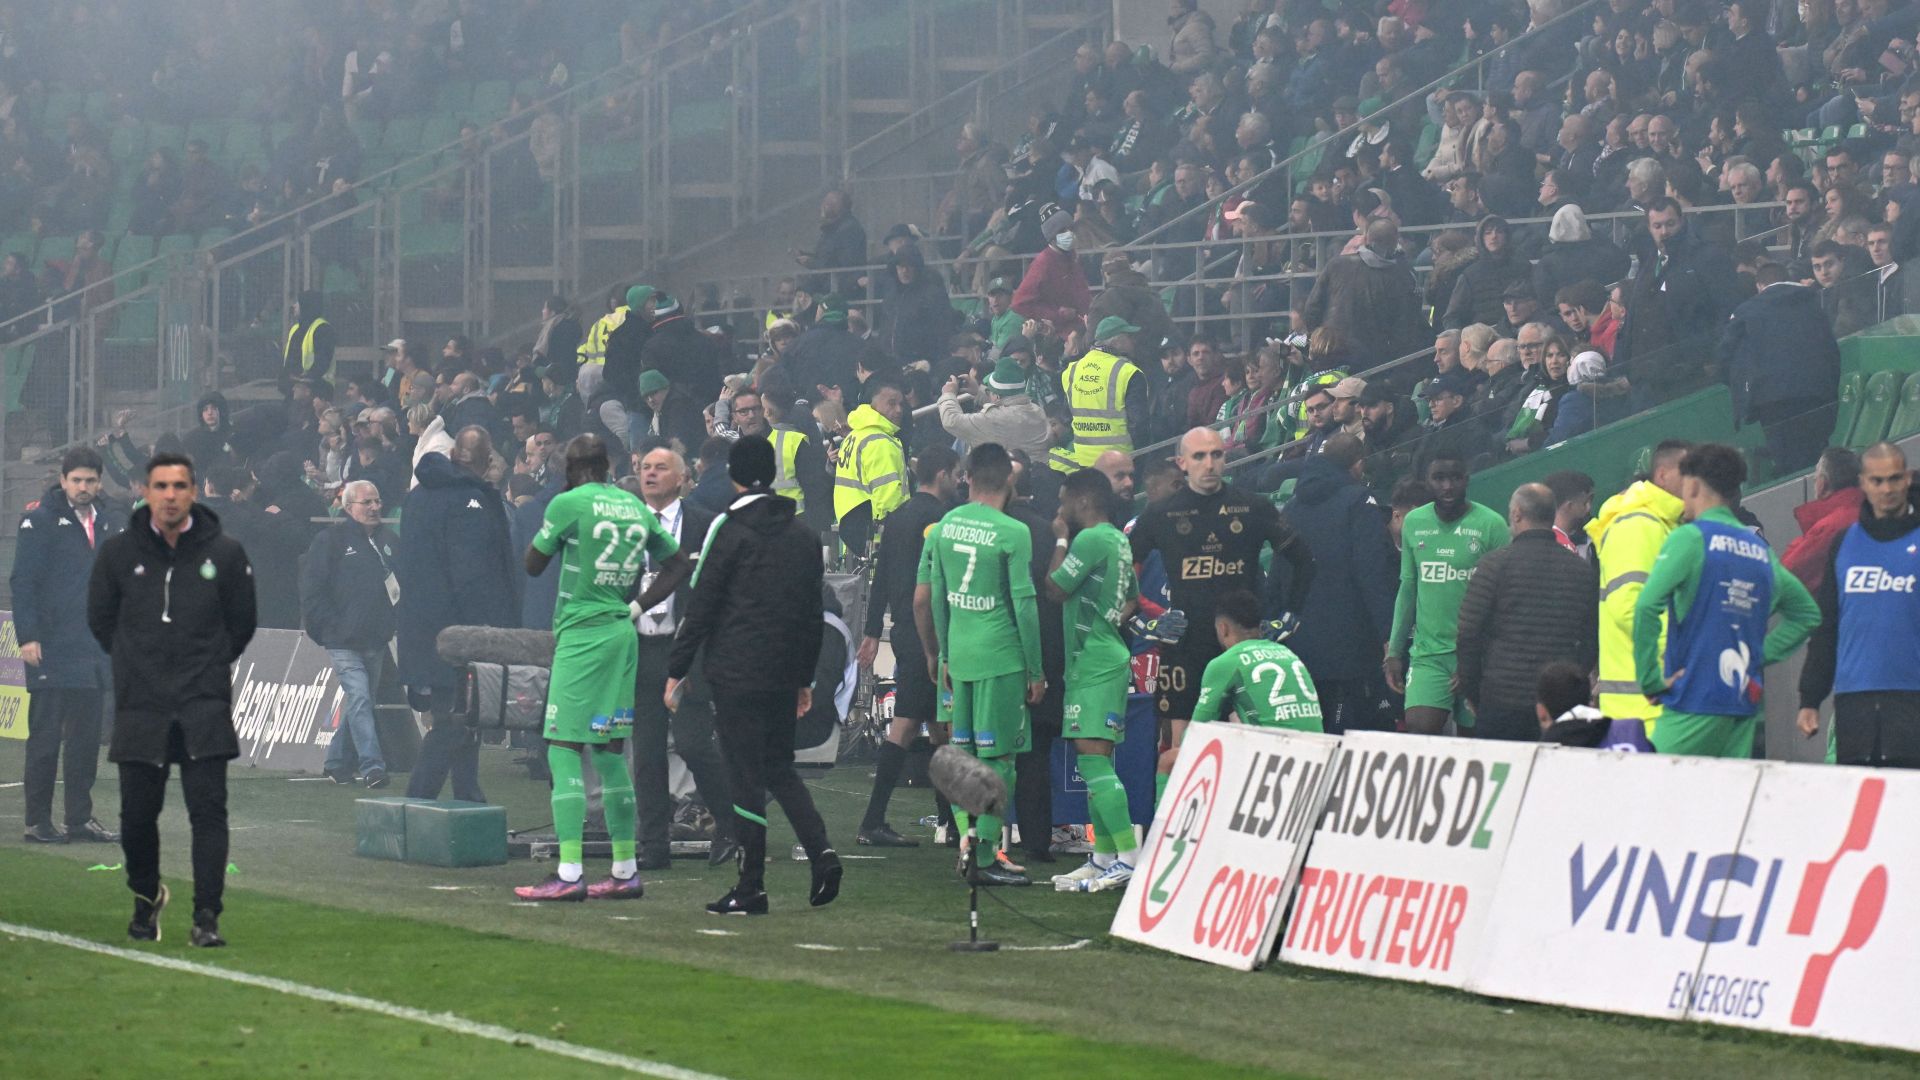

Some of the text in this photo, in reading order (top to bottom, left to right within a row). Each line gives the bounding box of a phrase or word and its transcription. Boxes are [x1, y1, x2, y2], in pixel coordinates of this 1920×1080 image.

[1080, 374, 1101, 383] ASSE
[592, 521, 649, 572] 22
[942, 523, 998, 547] BOUDEBOUZ
[953, 543, 977, 593] 7
[1182, 556, 1245, 579] ZEbet
[1845, 566, 1916, 593] ZEbet
[1159, 665, 1186, 692] 50
[1275, 703, 1323, 721] AFFLELO
[1229, 751, 1295, 838] LES
[1446, 759, 1511, 850] DZ
[1570, 841, 1783, 946] VINCI
[1668, 971, 1770, 1018] ENERGIES
